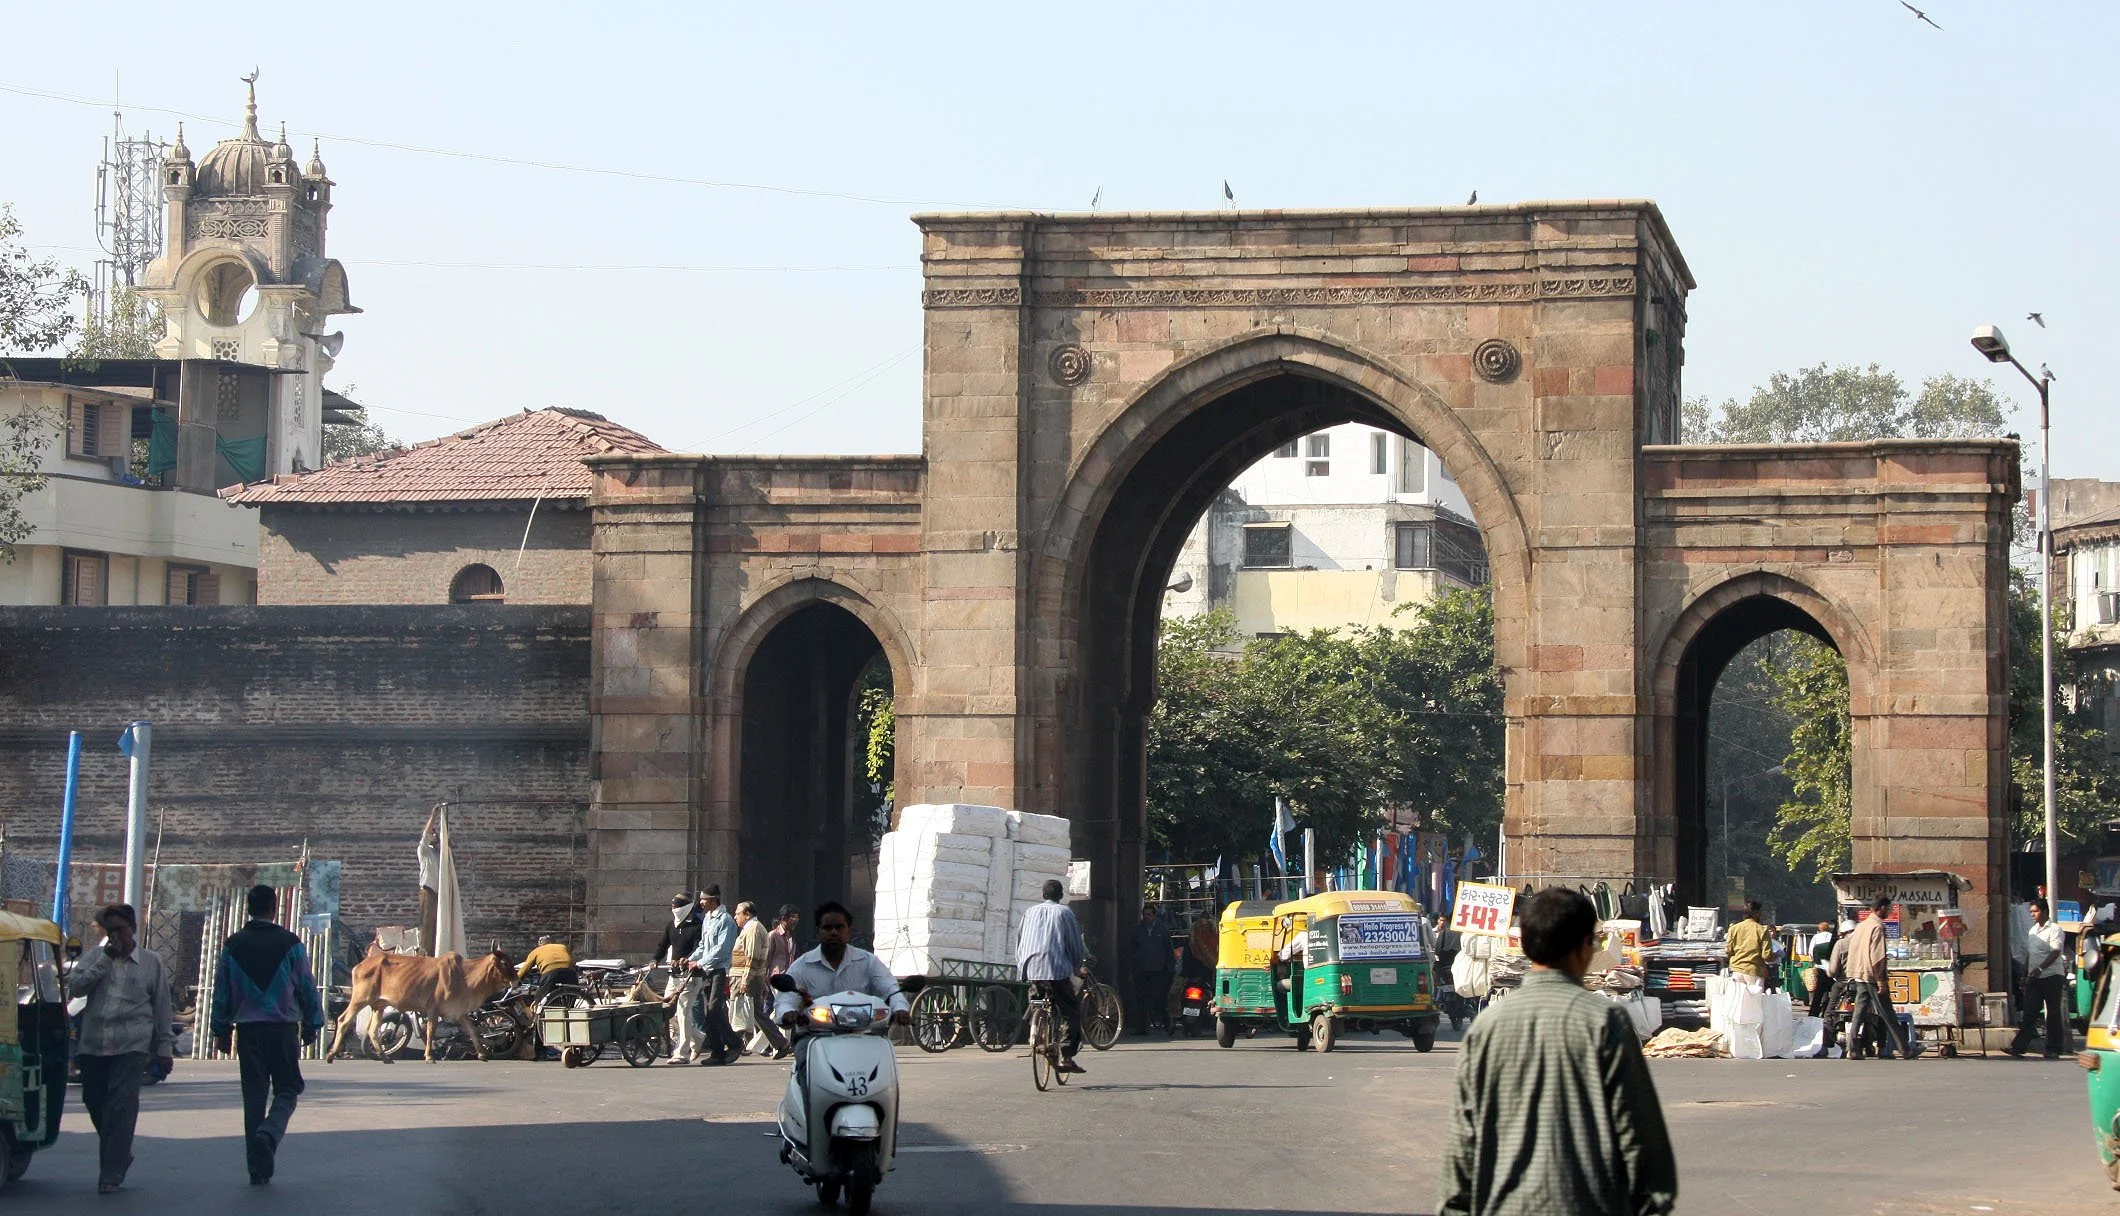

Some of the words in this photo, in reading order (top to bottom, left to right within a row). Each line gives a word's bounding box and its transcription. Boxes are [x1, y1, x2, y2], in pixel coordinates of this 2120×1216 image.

[1898, 890, 1943, 902] MASALA
[1364, 922, 1378, 931] Hello
[1380, 922, 1404, 931] Progress
[1244, 953, 1271, 963] RAA
[847, 1076, 868, 1096] 43
